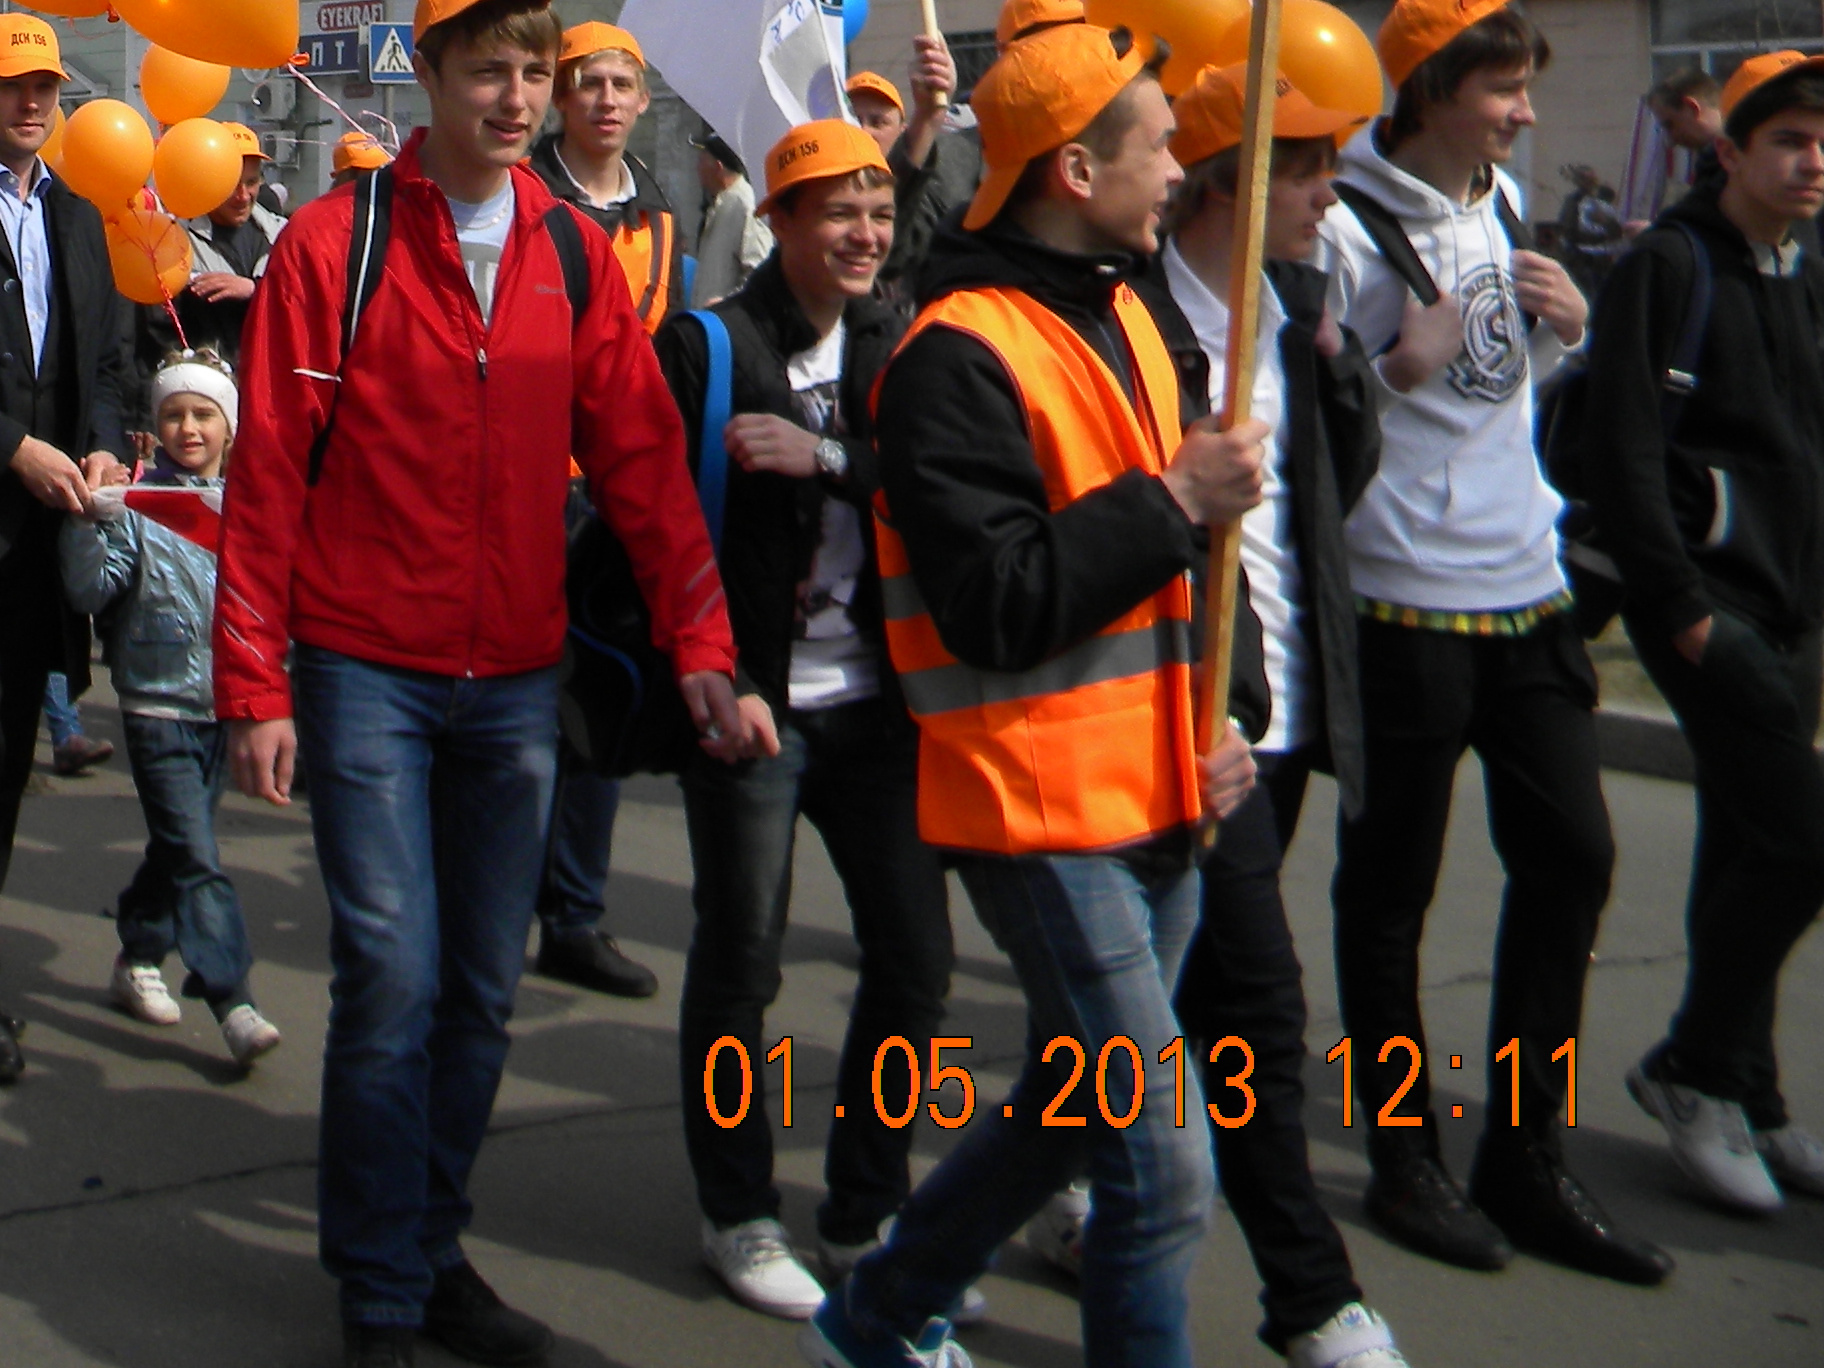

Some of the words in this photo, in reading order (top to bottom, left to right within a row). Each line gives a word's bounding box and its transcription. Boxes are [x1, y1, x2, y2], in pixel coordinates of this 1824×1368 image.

[11, 33, 30, 47] ДСК
[32, 33, 47, 47] 156
[778, 149, 798, 171] ДСК
[799, 140, 820, 158] 156
